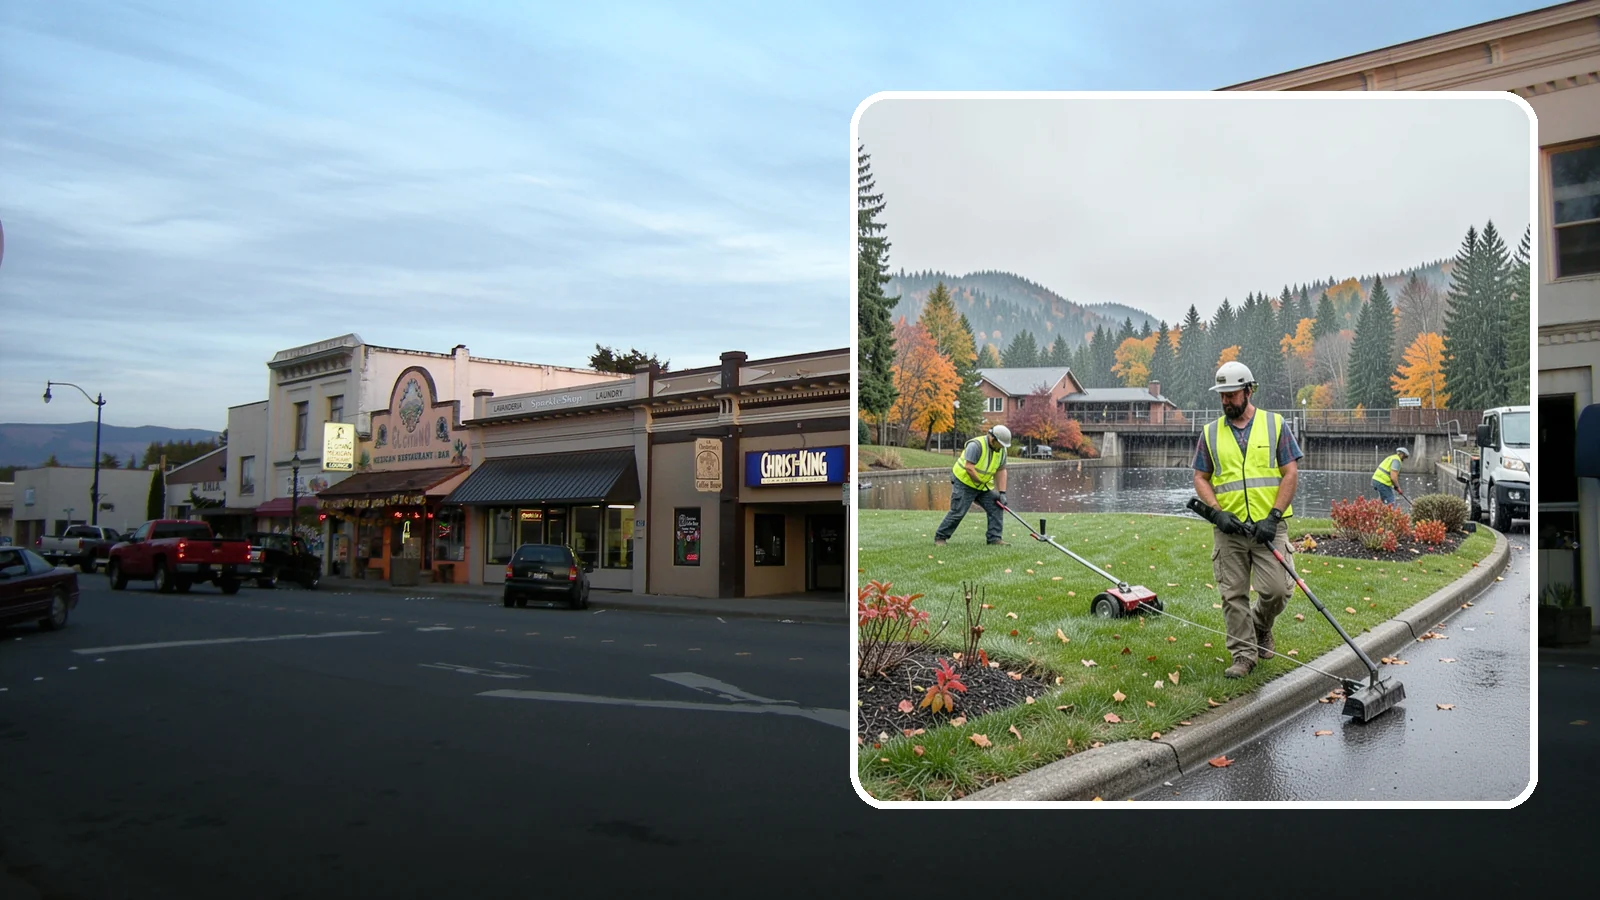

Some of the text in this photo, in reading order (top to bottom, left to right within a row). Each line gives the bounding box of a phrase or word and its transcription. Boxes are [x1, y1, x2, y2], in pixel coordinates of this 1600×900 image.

[595, 388, 624, 400] LAUNDRY
[560, 394, 583, 407] Shop
[493, 402, 523, 413] LAVANDERIA
[373, 455, 396, 464] MEXICAN
[397, 451, 433, 462] RESTAURANT
[438, 450, 450, 459] BAR
[761, 450, 827, 477] CHRIST KING
[696, 480, 722, 489] Coffee House
